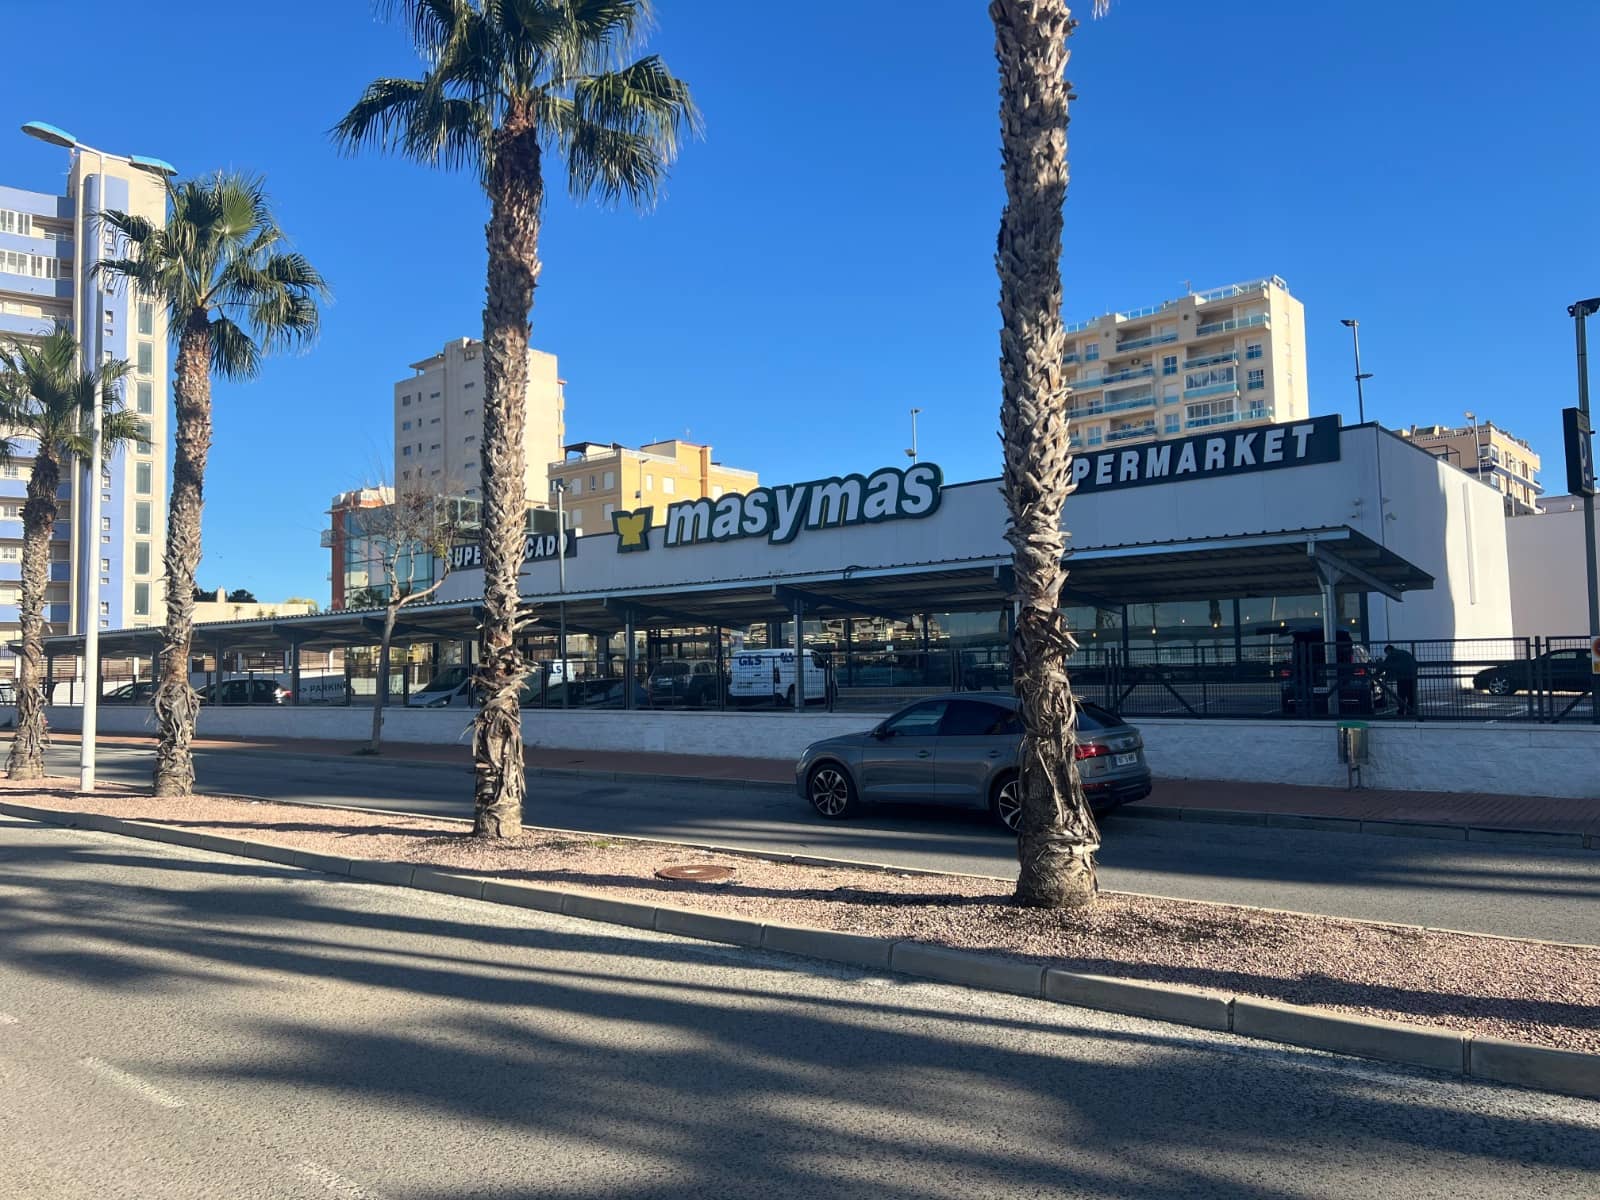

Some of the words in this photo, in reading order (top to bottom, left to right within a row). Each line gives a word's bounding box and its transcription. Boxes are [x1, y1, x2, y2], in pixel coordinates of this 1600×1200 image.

[1071, 424, 1315, 486] PERMARKET
[666, 466, 936, 544] masymas
[447, 533, 568, 567] SUPECADO
[739, 654, 762, 666] GLS
